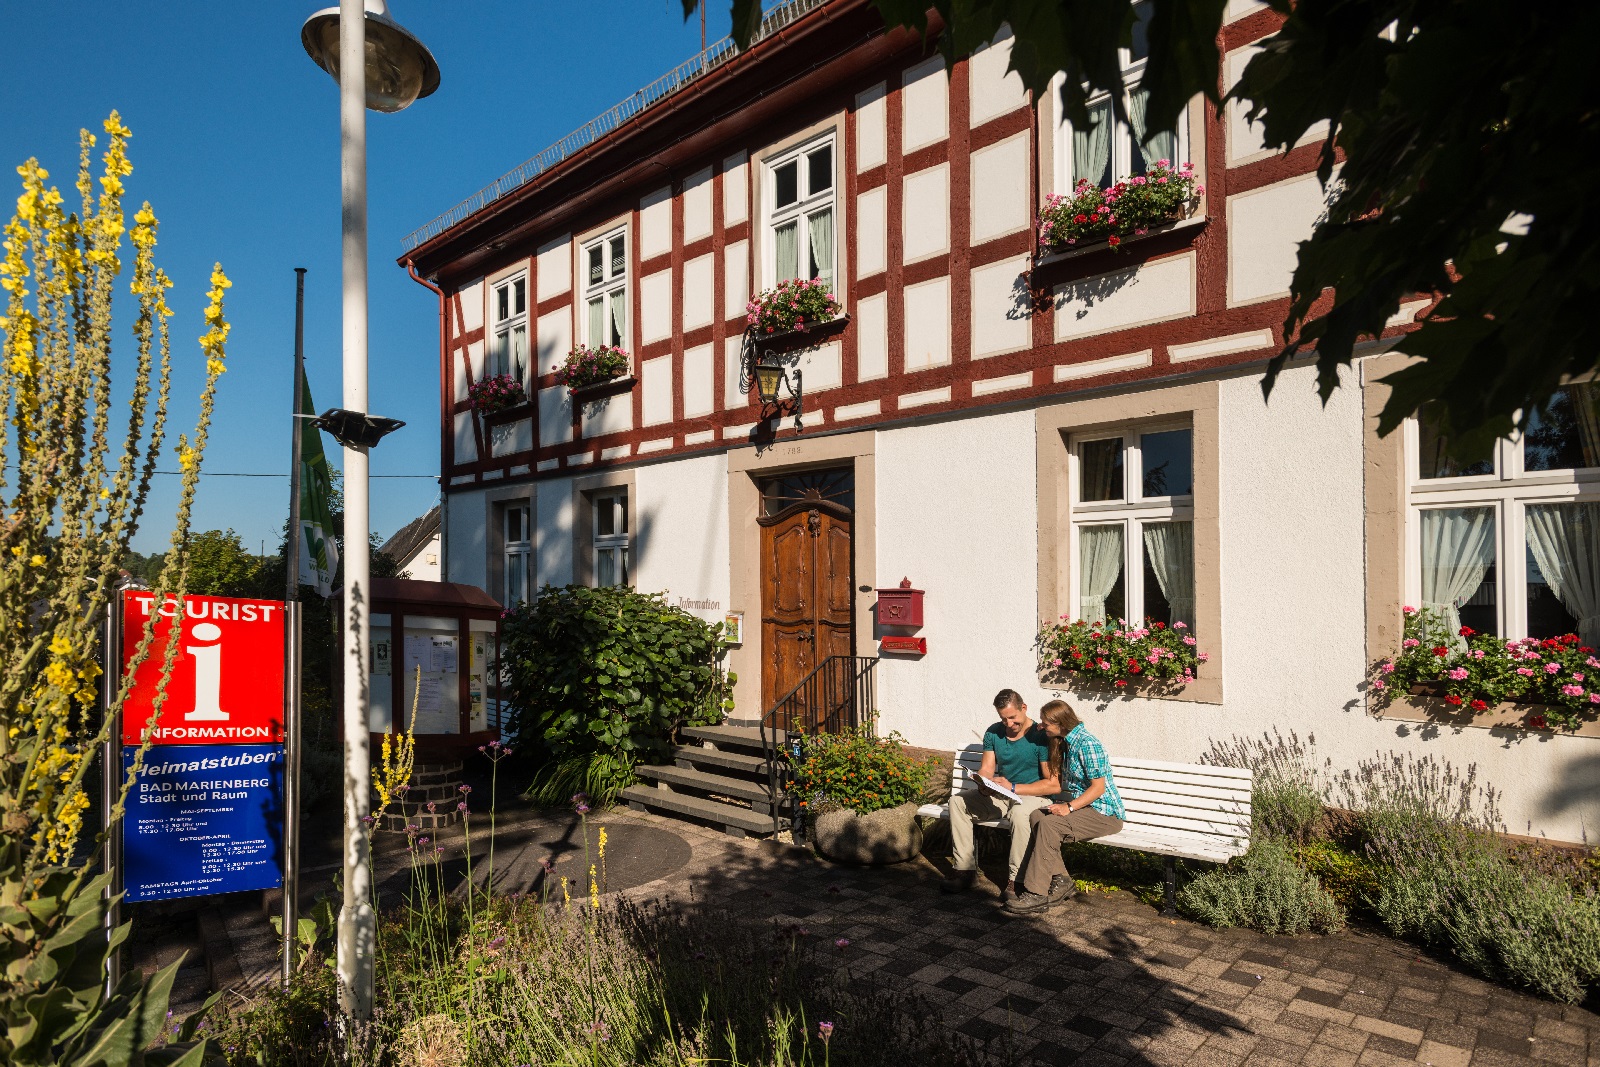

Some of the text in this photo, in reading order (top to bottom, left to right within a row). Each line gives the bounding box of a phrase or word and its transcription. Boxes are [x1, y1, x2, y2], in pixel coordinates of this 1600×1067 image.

[136, 597, 275, 622] TOURIST
[679, 596, 720, 610] Information
[141, 727, 269, 738] INFORMATION
[136, 752, 276, 777] Heimatstuben
[140, 779, 268, 792] BAD MARIENBERG
[140, 790, 247, 803] Stadt und Raum
